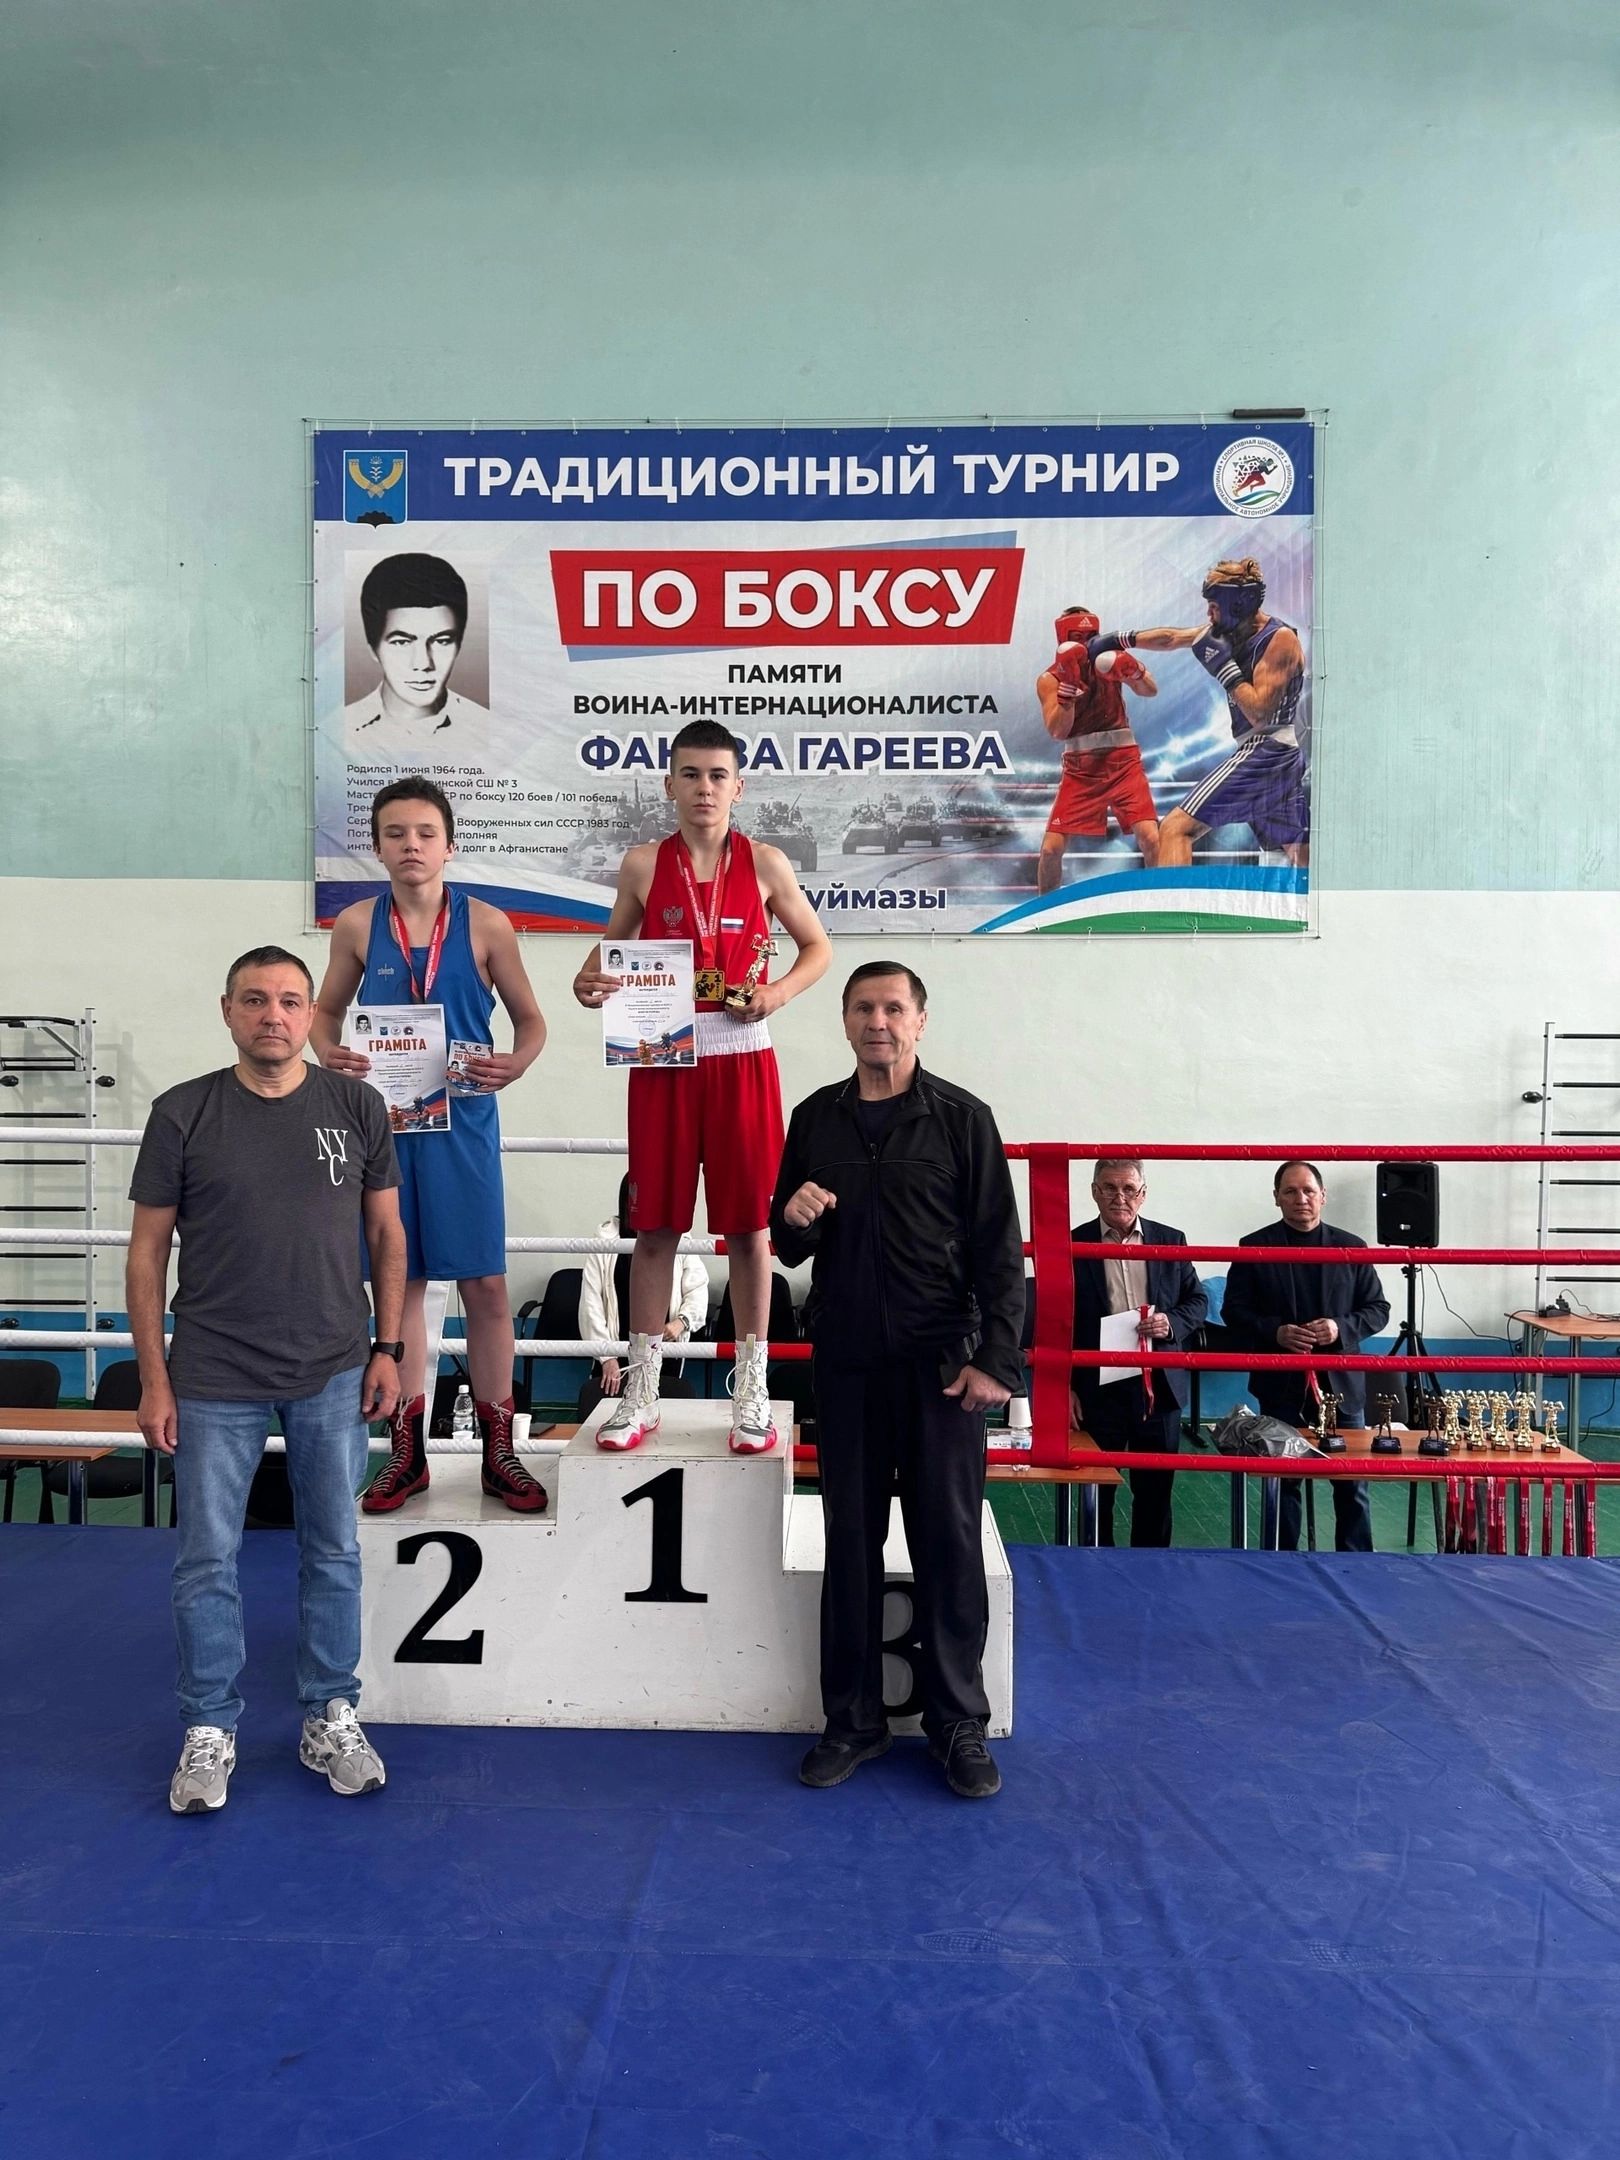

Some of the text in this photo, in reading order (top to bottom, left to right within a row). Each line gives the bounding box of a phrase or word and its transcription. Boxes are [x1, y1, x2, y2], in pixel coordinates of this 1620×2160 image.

[1222, 439, 1257, 460] СПОРТИВНАЯ
[1257, 439, 1278, 452] ШКОЛА
[444, 444, 1180, 504] ТРАДИЦИОННЫЙ ТУРНИР
[1216, 466, 1239, 511] МУНИЦИПАЛЬНОЕ
[1240, 504, 1279, 516] АВТОНОМНОЕ
[582, 567, 996, 630] ПО БОКСУ
[728, 664, 842, 684] ПАМЯТИ
[573, 694, 998, 718] ВОИНА-ИНТЕРНАЦИОНАЛИСТА
[799, 736, 1006, 770] ГАРЕЕВА
[347, 765, 485, 776] Родился 1 июня 1964 года.
[347, 778, 385, 787] Учился
[476, 779, 494, 788] СШ
[497, 779, 509, 788] №
[511, 780, 518, 788] 3
[459, 793, 473, 801] по
[475, 791, 506, 803] боксу
[508, 792, 525, 801] 120
[527, 792, 553, 802] боев
[562, 793, 576, 802] 101
[579, 793, 618, 803] победа
[457, 818, 532, 829] Вооруженных
[534, 820, 554, 828] сил
[556, 819, 585, 828] СССР
[587, 819, 610, 829] 1983
[452, 831, 498, 840] ыполняя
[462, 845, 487, 854] долг
[489, 845, 496, 853] в
[498, 843, 569, 855] Афганистане
[620, 973, 676, 988] ГРАМОТА
[368, 1038, 427, 1052] ГРАМОТА
[620, 1467, 708, 1603] 1
[394, 1530, 485, 1665] 2
